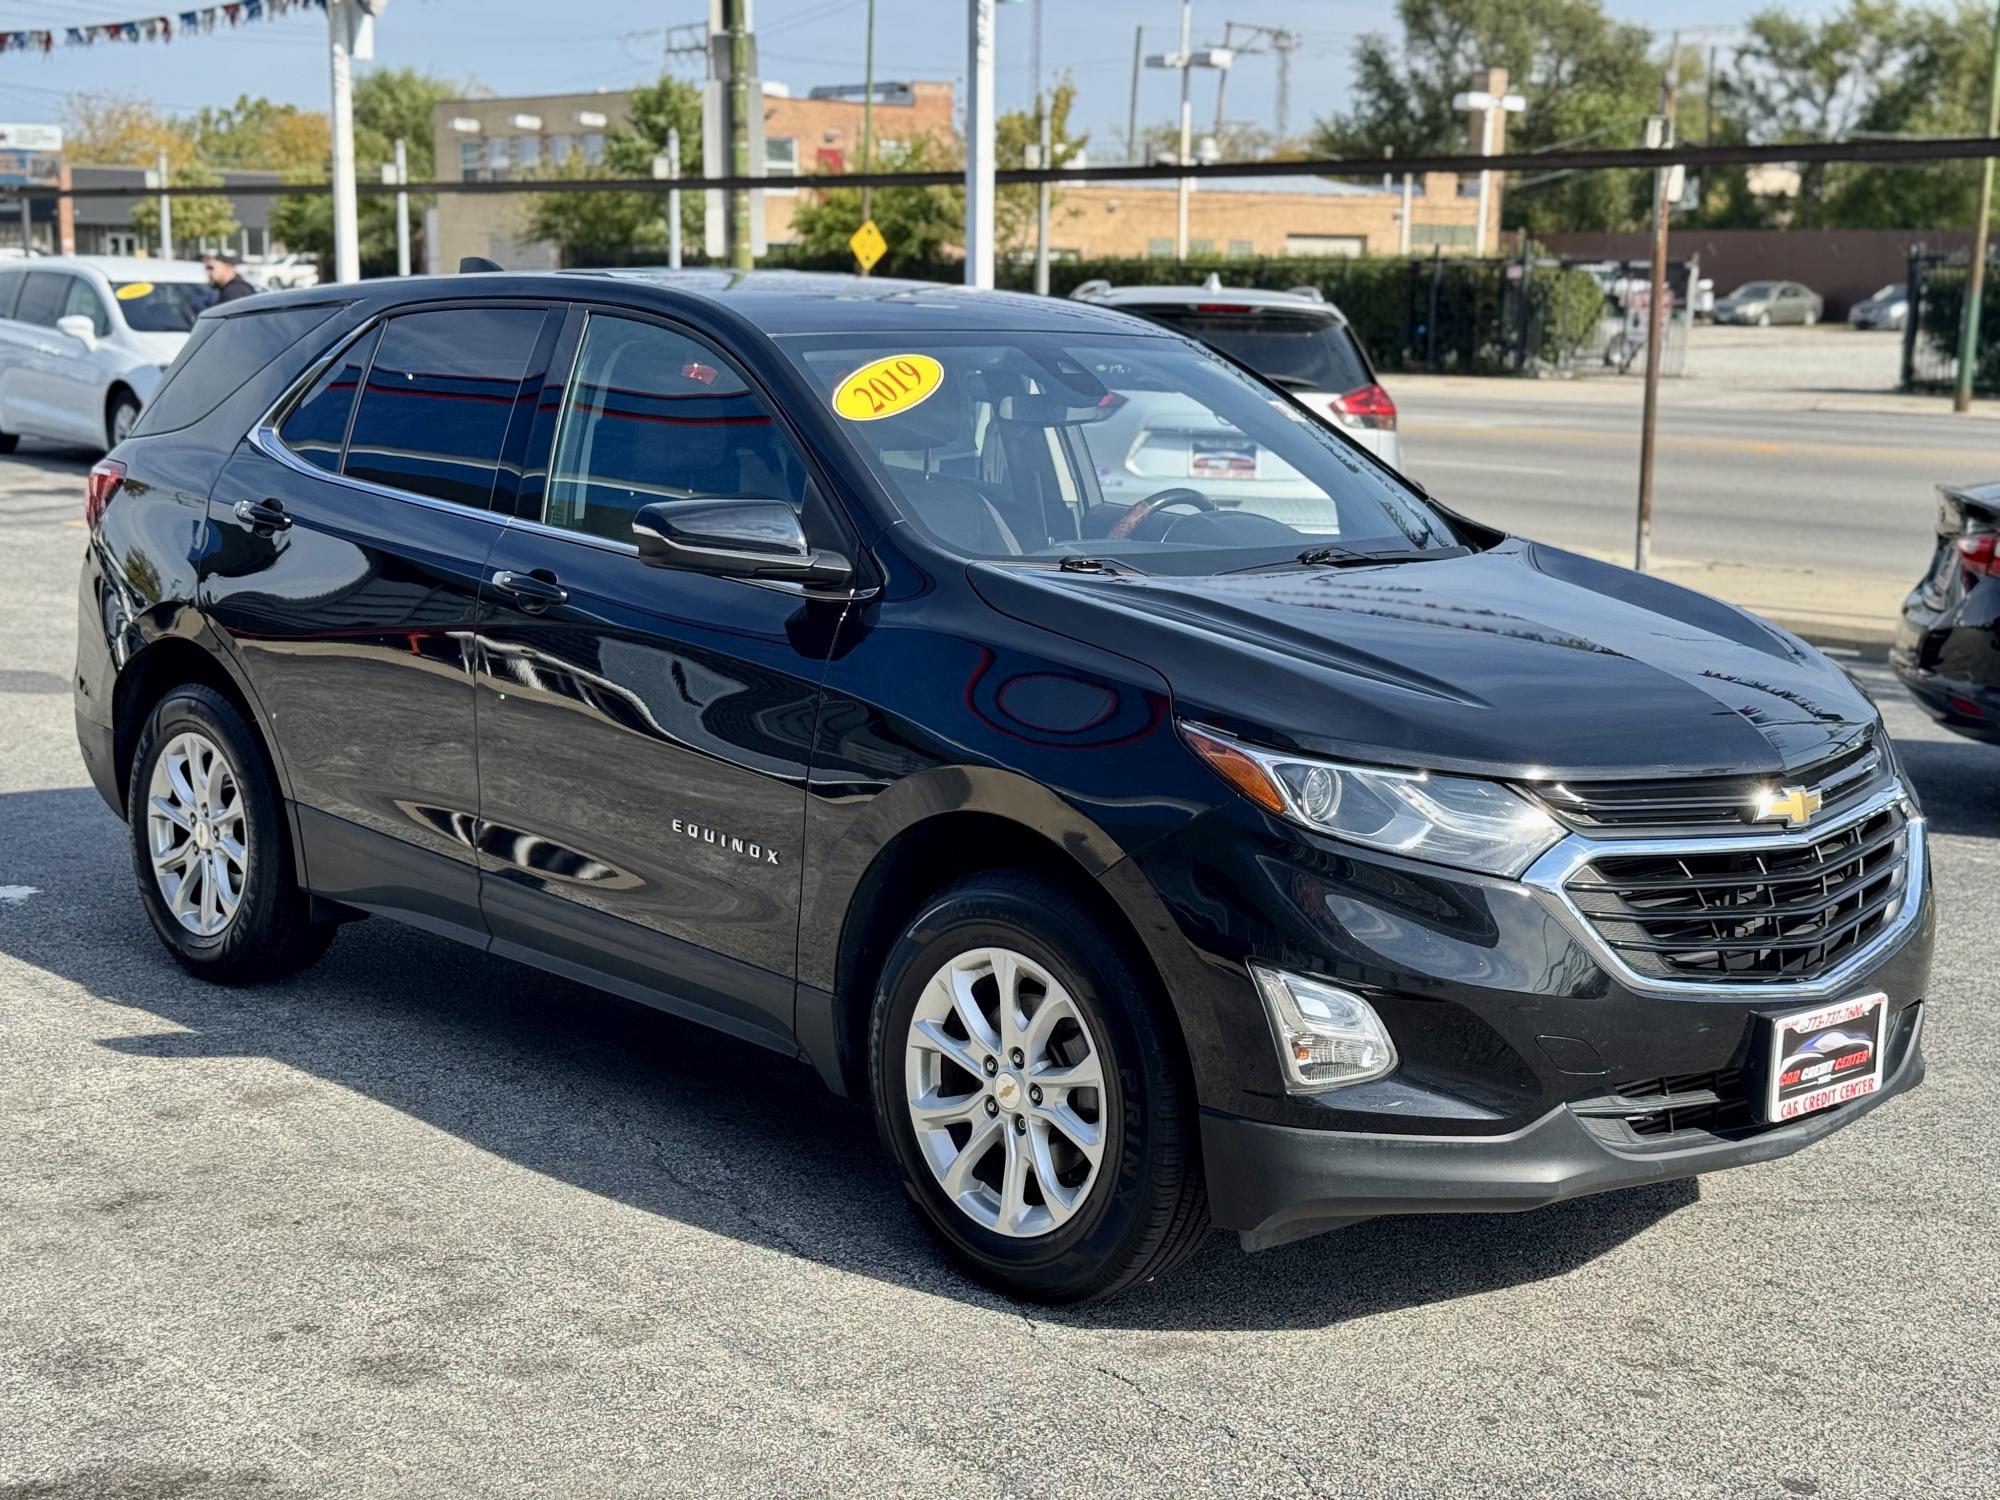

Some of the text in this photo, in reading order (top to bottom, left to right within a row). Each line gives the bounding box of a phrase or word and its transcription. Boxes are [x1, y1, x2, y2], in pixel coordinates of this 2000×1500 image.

[853, 360, 922, 413] 2019
[671, 818, 780, 865] EQUINOX
[1835, 1051, 1868, 1070] CENTER
[1781, 1078, 1874, 1118] CAR CREDIT CENTER
